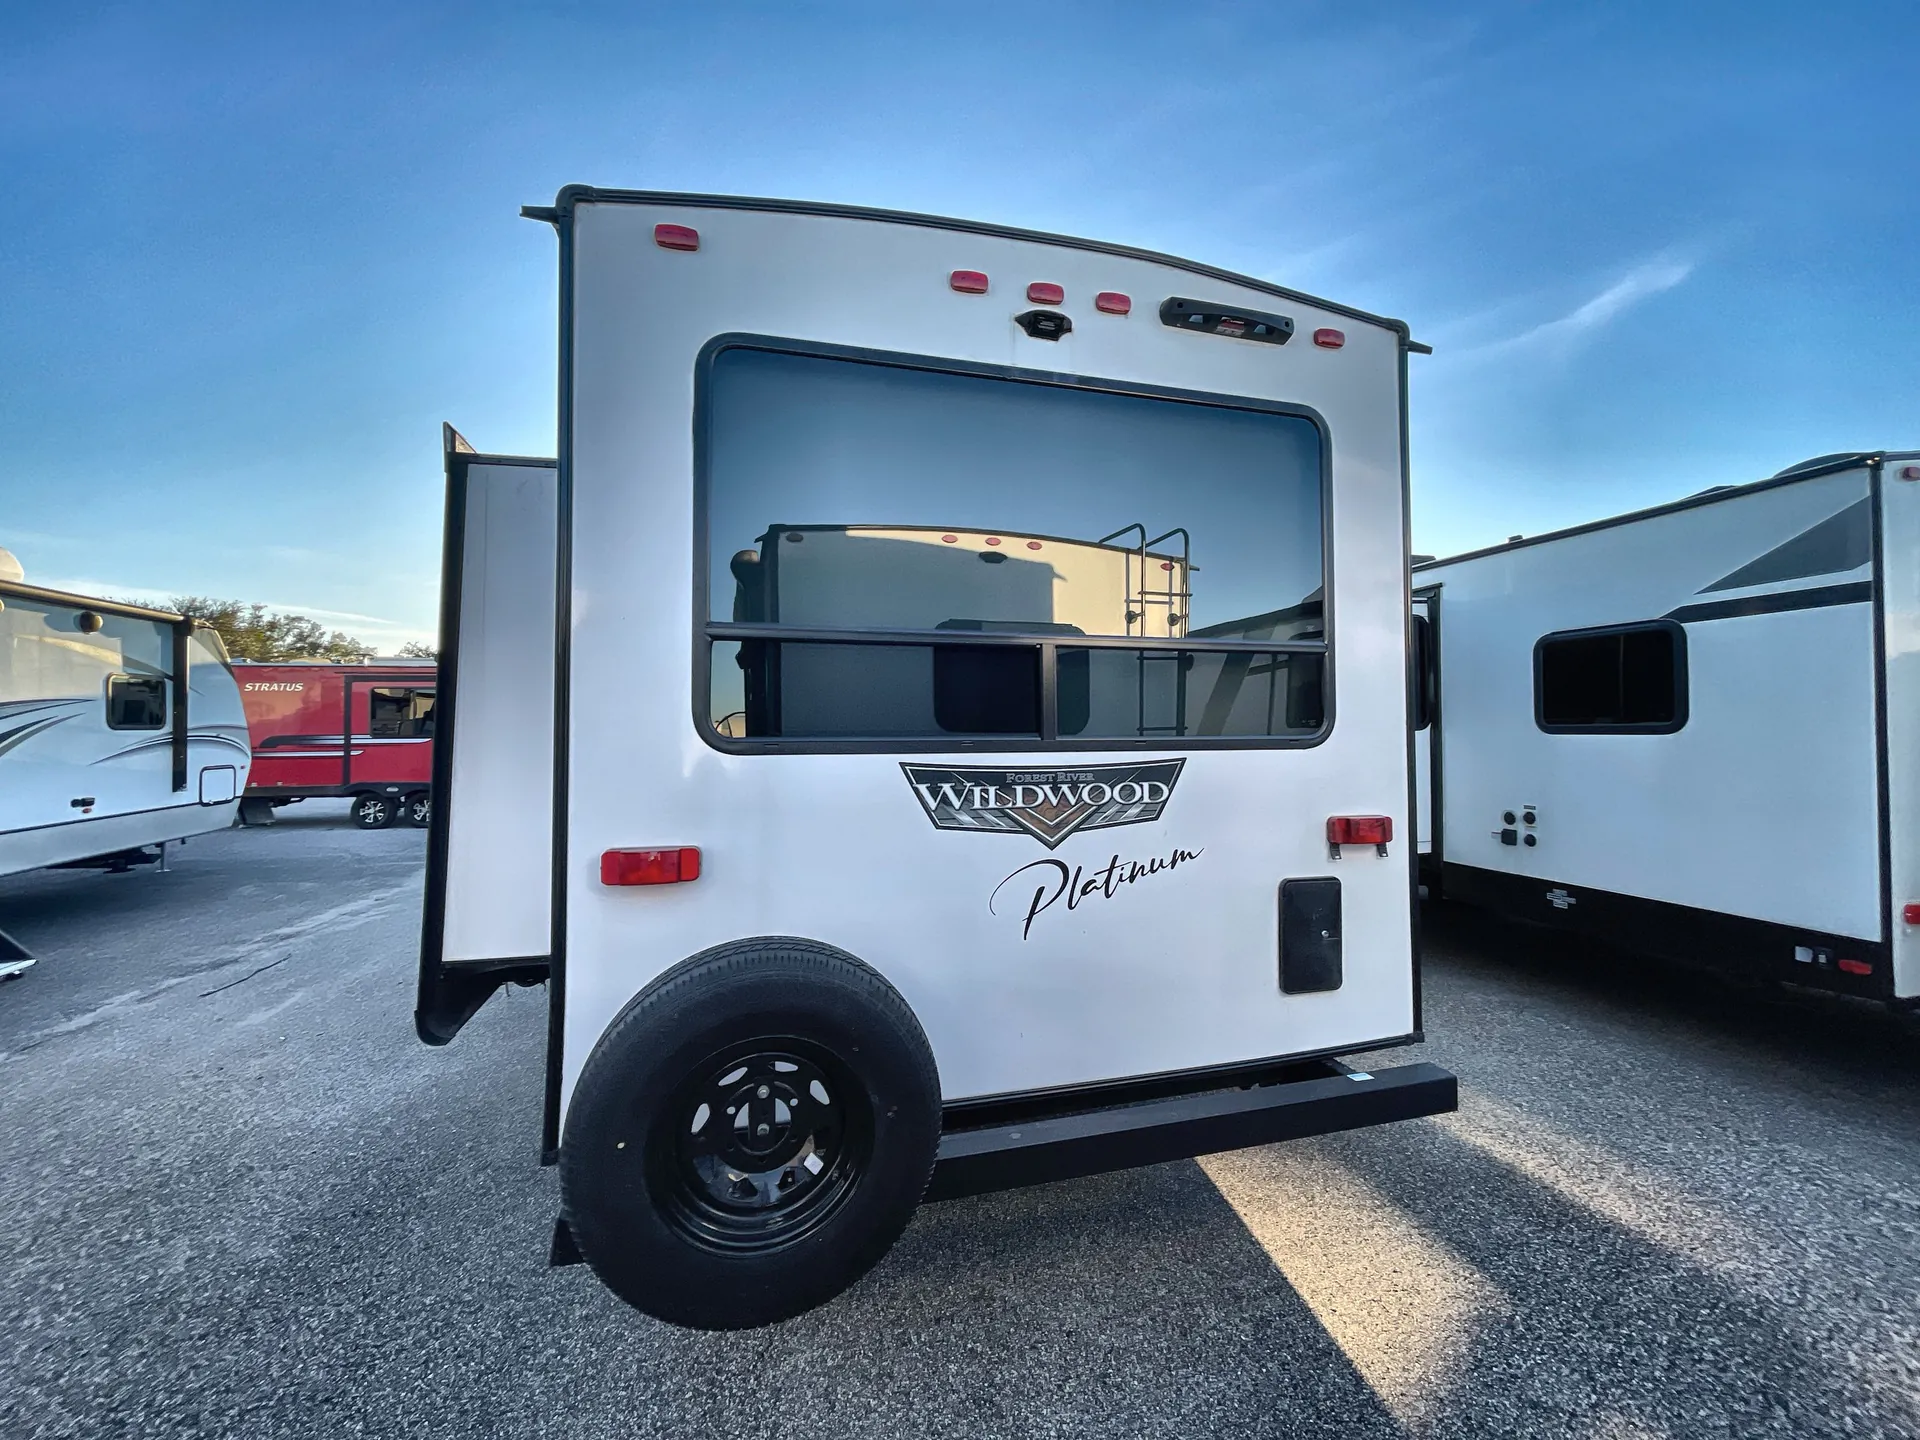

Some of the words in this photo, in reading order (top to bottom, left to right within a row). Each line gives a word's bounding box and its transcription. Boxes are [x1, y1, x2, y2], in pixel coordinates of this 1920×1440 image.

[243, 682, 304, 692] STRATUS
[1006, 772, 1055, 783] FOREST
[1056, 771, 1095, 782] RIVER
[913, 781, 1170, 811] WILDWOOD
[989, 847, 1205, 941] Platinum
